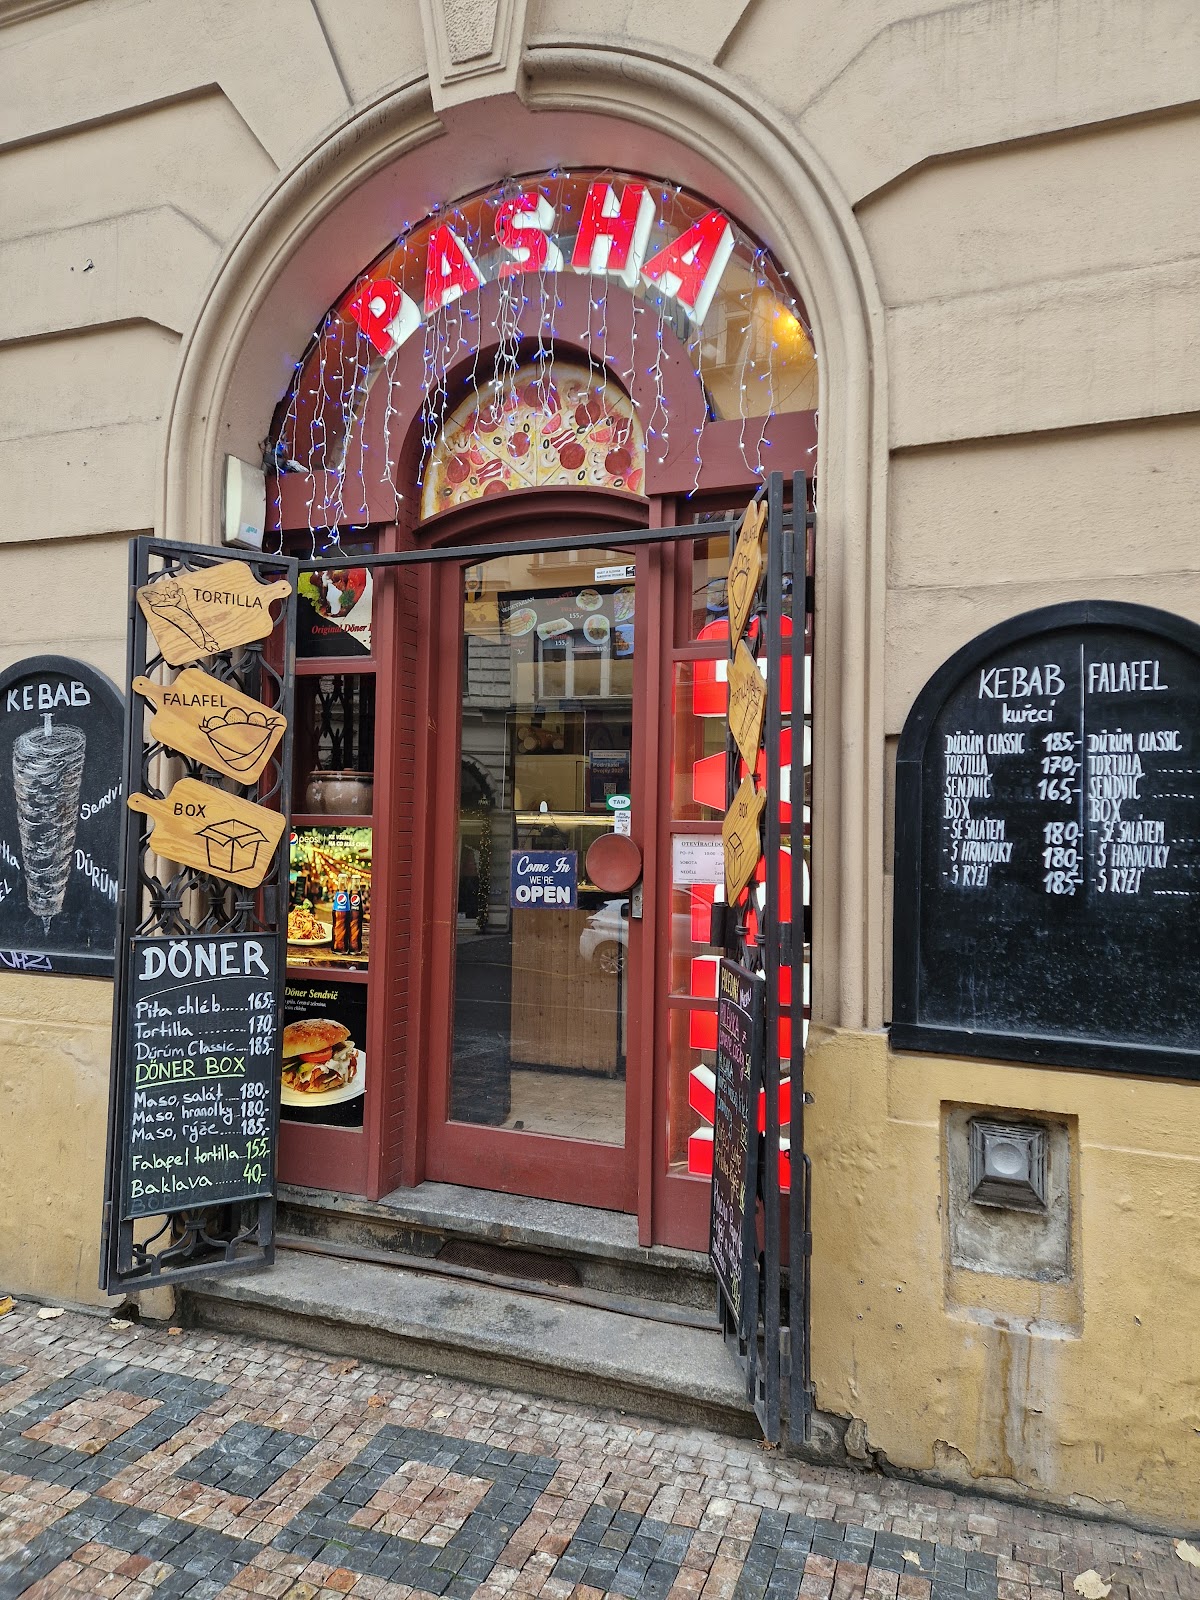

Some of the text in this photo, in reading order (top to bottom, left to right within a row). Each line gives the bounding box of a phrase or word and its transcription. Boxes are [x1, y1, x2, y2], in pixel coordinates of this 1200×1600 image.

[349, 183, 734, 357] PASHA
[193, 588, 263, 609] TORTILLA
[312, 624, 368, 636] Original Döner
[979, 664, 1065, 699] KEBAB
[1088, 661, 1168, 694] FALAFEL
[6, 681, 90, 712] KEBAB
[164, 693, 228, 708] FALAFEL
[1003, 700, 1056, 723] kuřecí
[987, 733, 1025, 754] CLASSIC
[1138, 731, 1182, 752] CLASSIC
[944, 754, 992, 775] TORTILLA
[1088, 754, 1145, 776] TORTILLA
[80, 777, 123, 820] Sendvi
[944, 799, 970, 819] BOX
[174, 802, 206, 818] BOX
[739, 802, 748, 820] BOX
[1090, 799, 1120, 822] BOX
[1119, 814, 1164, 842] SALÁTEM
[0, 841, 20, 870] lla
[961, 842, 1013, 863] HRANOLKY
[1111, 845, 1170, 868] HRANOLKY
[75, 849, 119, 902] DÜRÜM
[517, 856, 571, 876] Come In
[530, 876, 554, 885] WE'RE
[516, 886, 571, 904] OPEN
[139, 940, 270, 980] DÖNER
[285, 987, 338, 1000] Döner Sendvič
[136, 1002, 172, 1019] Pita
[177, 994, 221, 1014] chléb
[134, 1020, 194, 1039] Tortilla
[188, 1040, 235, 1056] Classic
[135, 1056, 246, 1082] DÖNER BOX
[133, 1091, 179, 1108] Maso,
[182, 1086, 224, 1105] salát
[132, 1110, 175, 1126] Maso,
[181, 1102, 234, 1125] hranolky
[131, 1127, 176, 1143] Maso,
[182, 1121, 219, 1143] rýže
[194, 1142, 240, 1163] tortilla
[131, 1173, 213, 1198] Baklava
